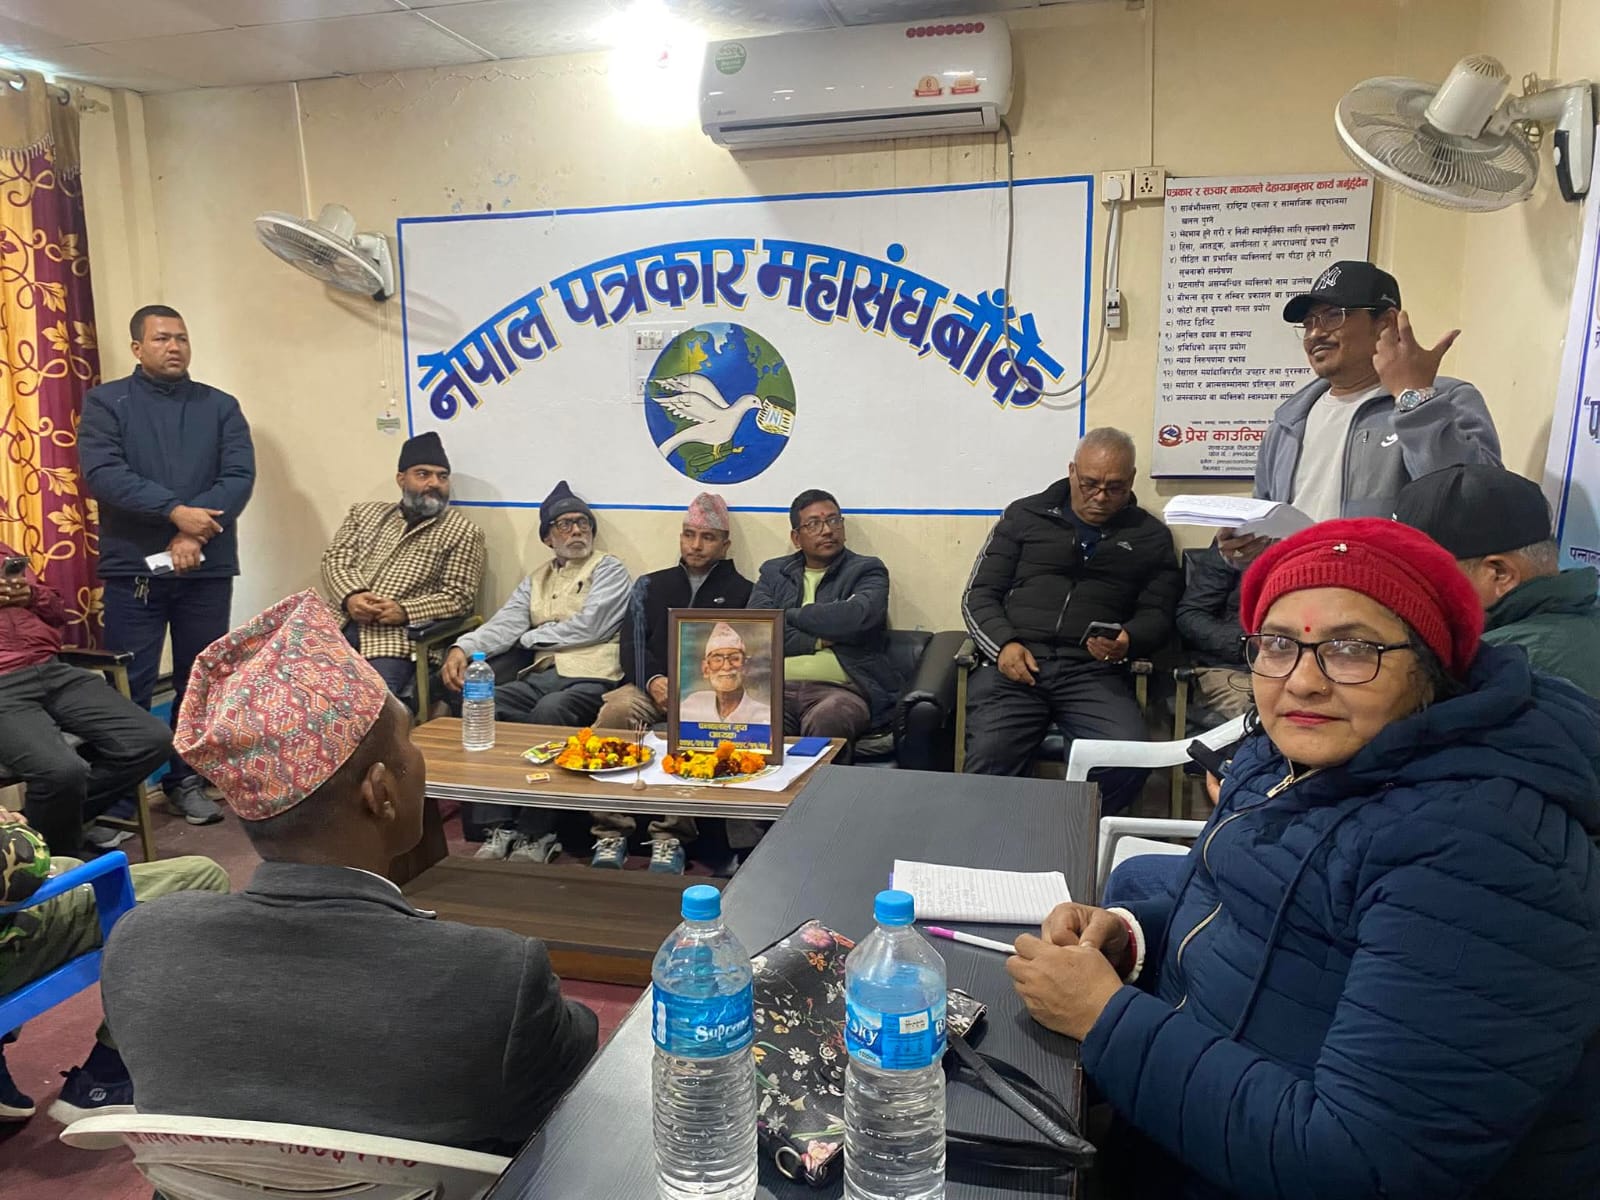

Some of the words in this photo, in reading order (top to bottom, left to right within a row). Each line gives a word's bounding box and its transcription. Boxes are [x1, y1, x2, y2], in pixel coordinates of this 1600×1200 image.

[1167, 187, 1193, 197] पत्रकार
[1195, 187, 1201, 196] र
[417, 288, 559, 421] नेपाल
[550, 238, 757, 328] पत्रकार
[1185, 426, 1209, 444] प्रेस
[1212, 426, 1267, 441] काउन्सि
